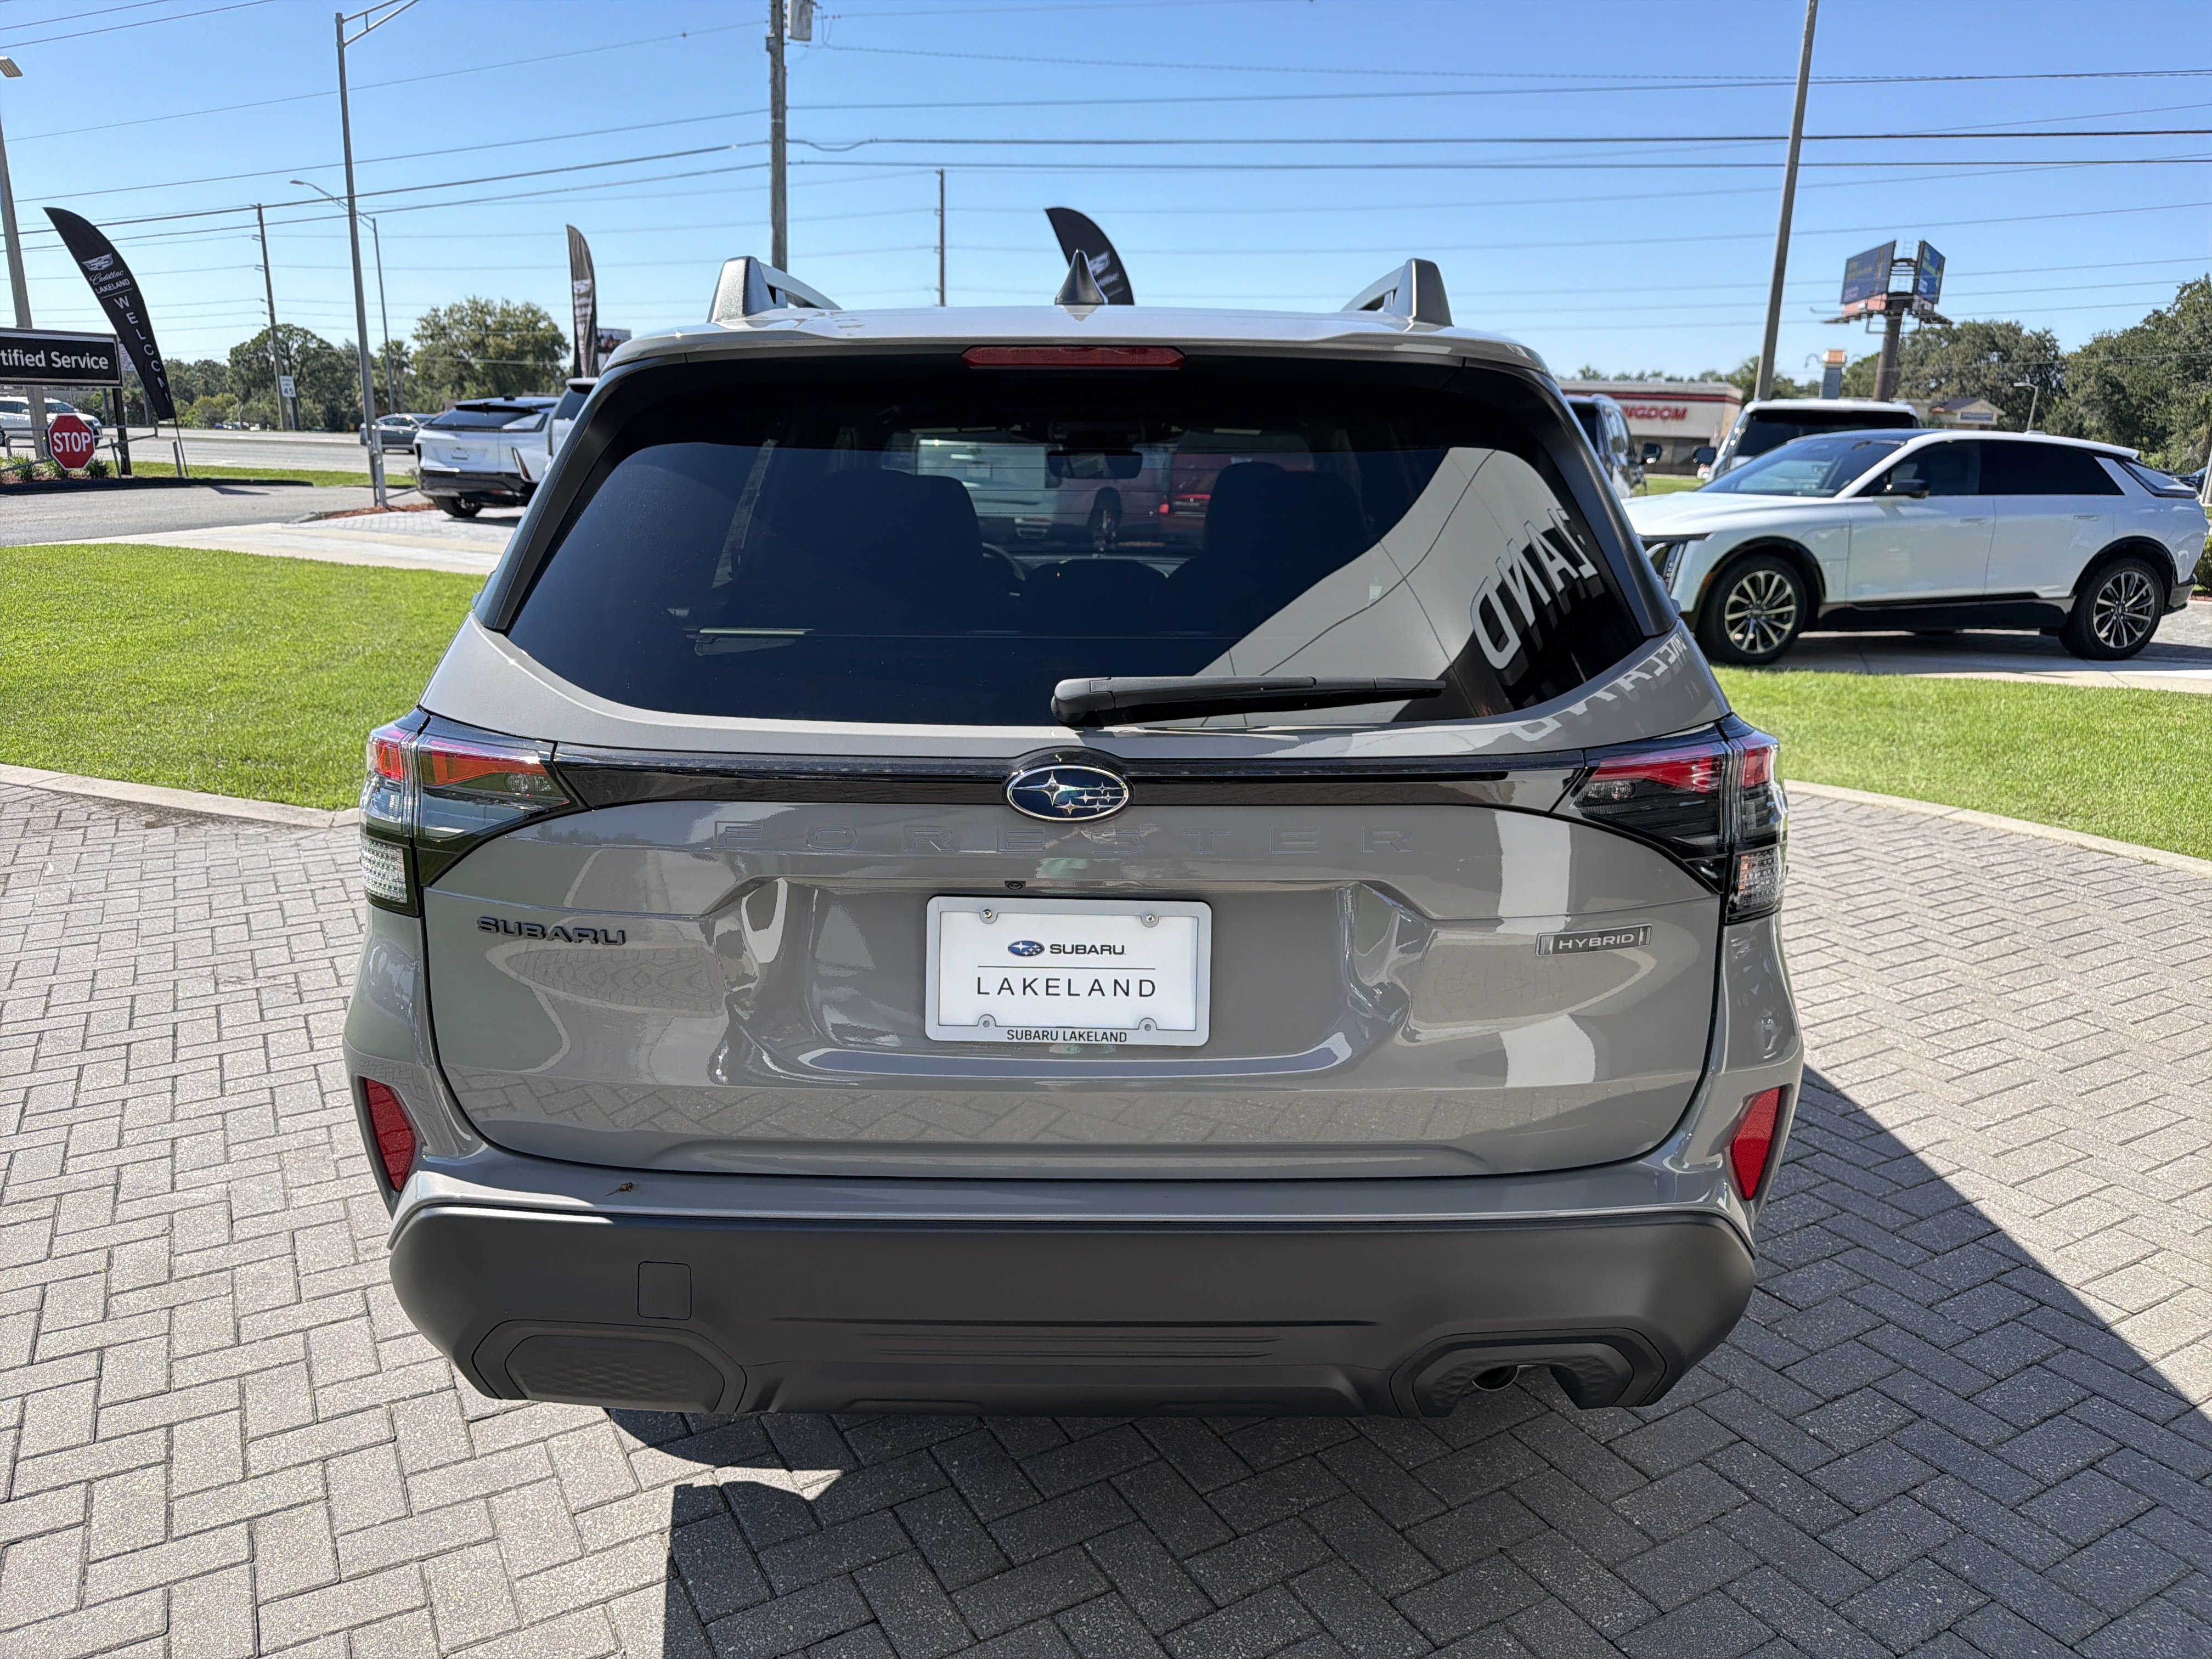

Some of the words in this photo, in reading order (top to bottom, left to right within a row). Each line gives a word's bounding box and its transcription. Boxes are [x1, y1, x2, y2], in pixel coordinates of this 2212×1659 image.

[89, 270, 124, 285] Cadillac
[95, 278, 131, 295] LAKELAND
[50, 351, 109, 370] Service
[53, 432, 91, 453] STOP
[714, 821, 1414, 855] FORESTER
[476, 916, 627, 946] SUBARU
[1049, 944, 1125, 956] SUBARU
[1559, 934, 1635, 950] HYBRID
[977, 977, 1156, 997] LAKELAND
[1006, 1029, 1058, 1041] SUBARU
[1062, 1031, 1127, 1042] LAKELAND
